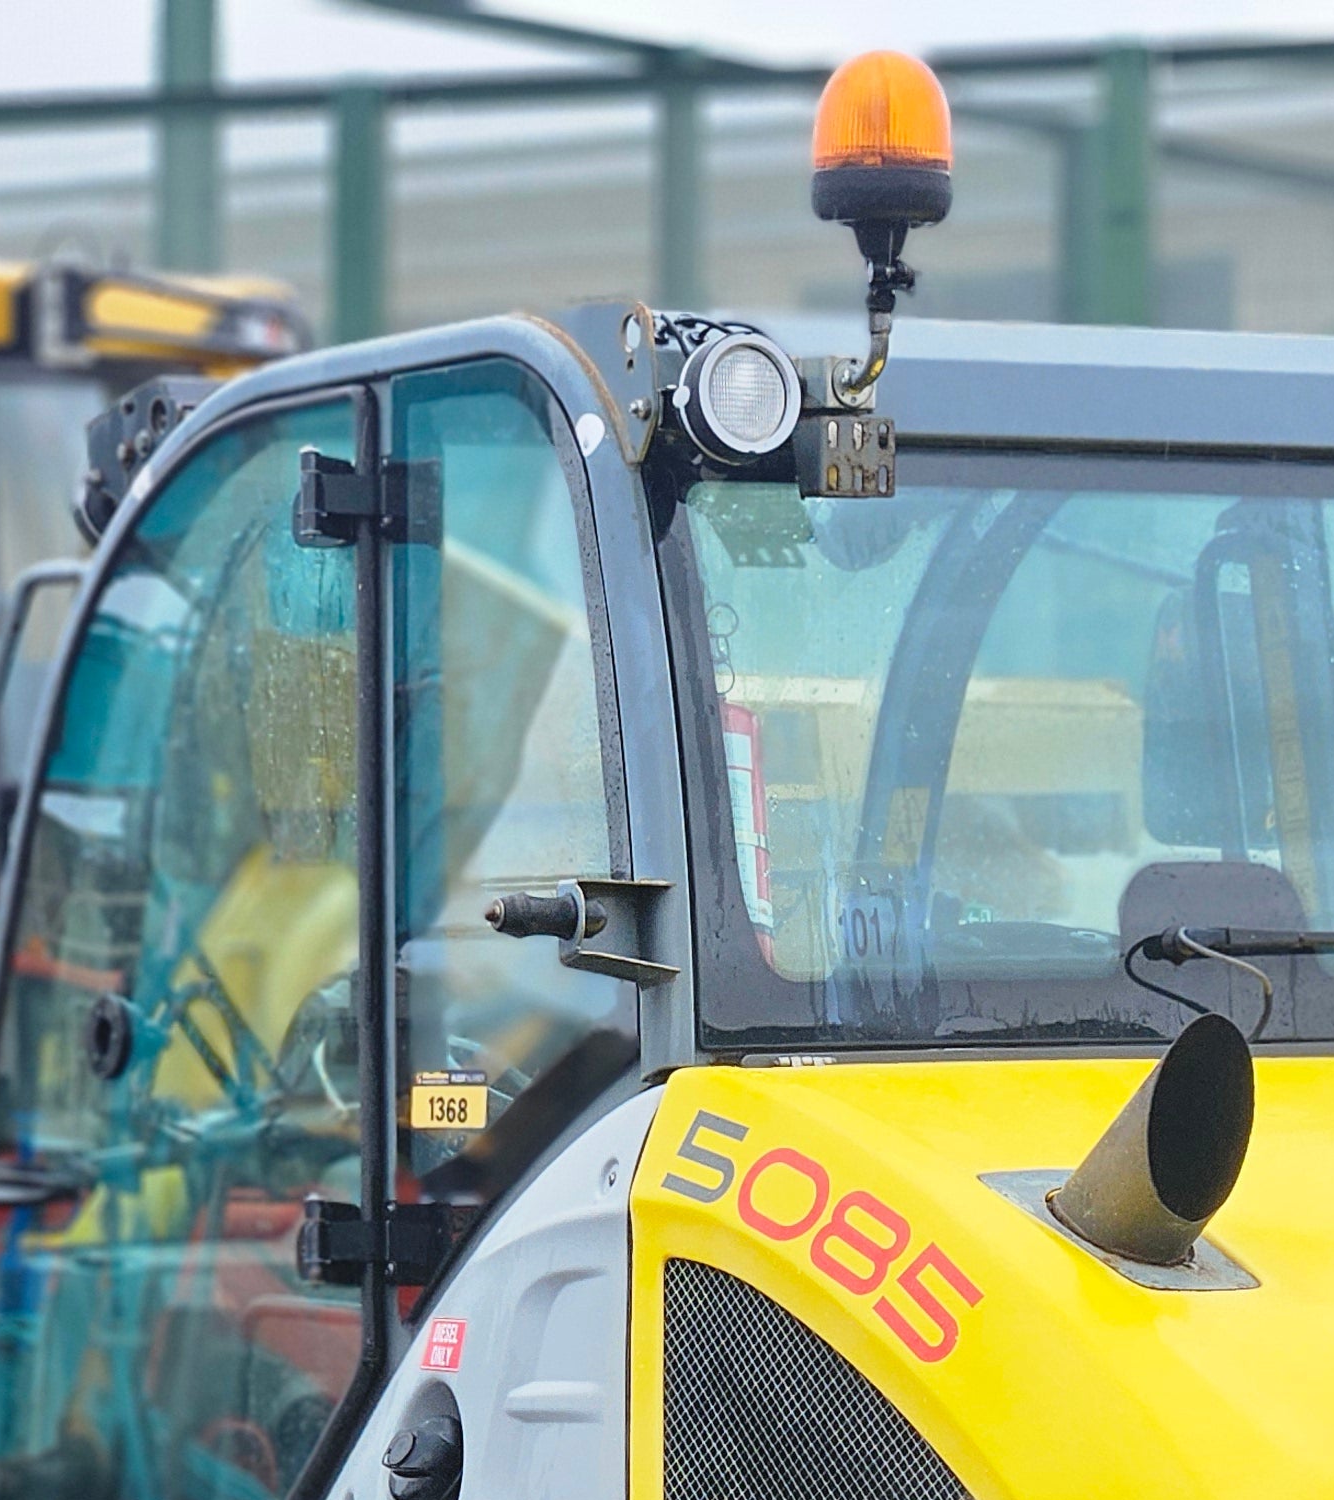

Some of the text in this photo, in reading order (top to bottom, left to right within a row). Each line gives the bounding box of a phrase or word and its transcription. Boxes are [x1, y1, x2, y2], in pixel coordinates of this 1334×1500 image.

[428, 1096, 468, 1124] 1368
[661, 1109, 985, 1363] 5085
[432, 1322, 458, 1344] DIESEL
[429, 1345, 454, 1366] ONLY
